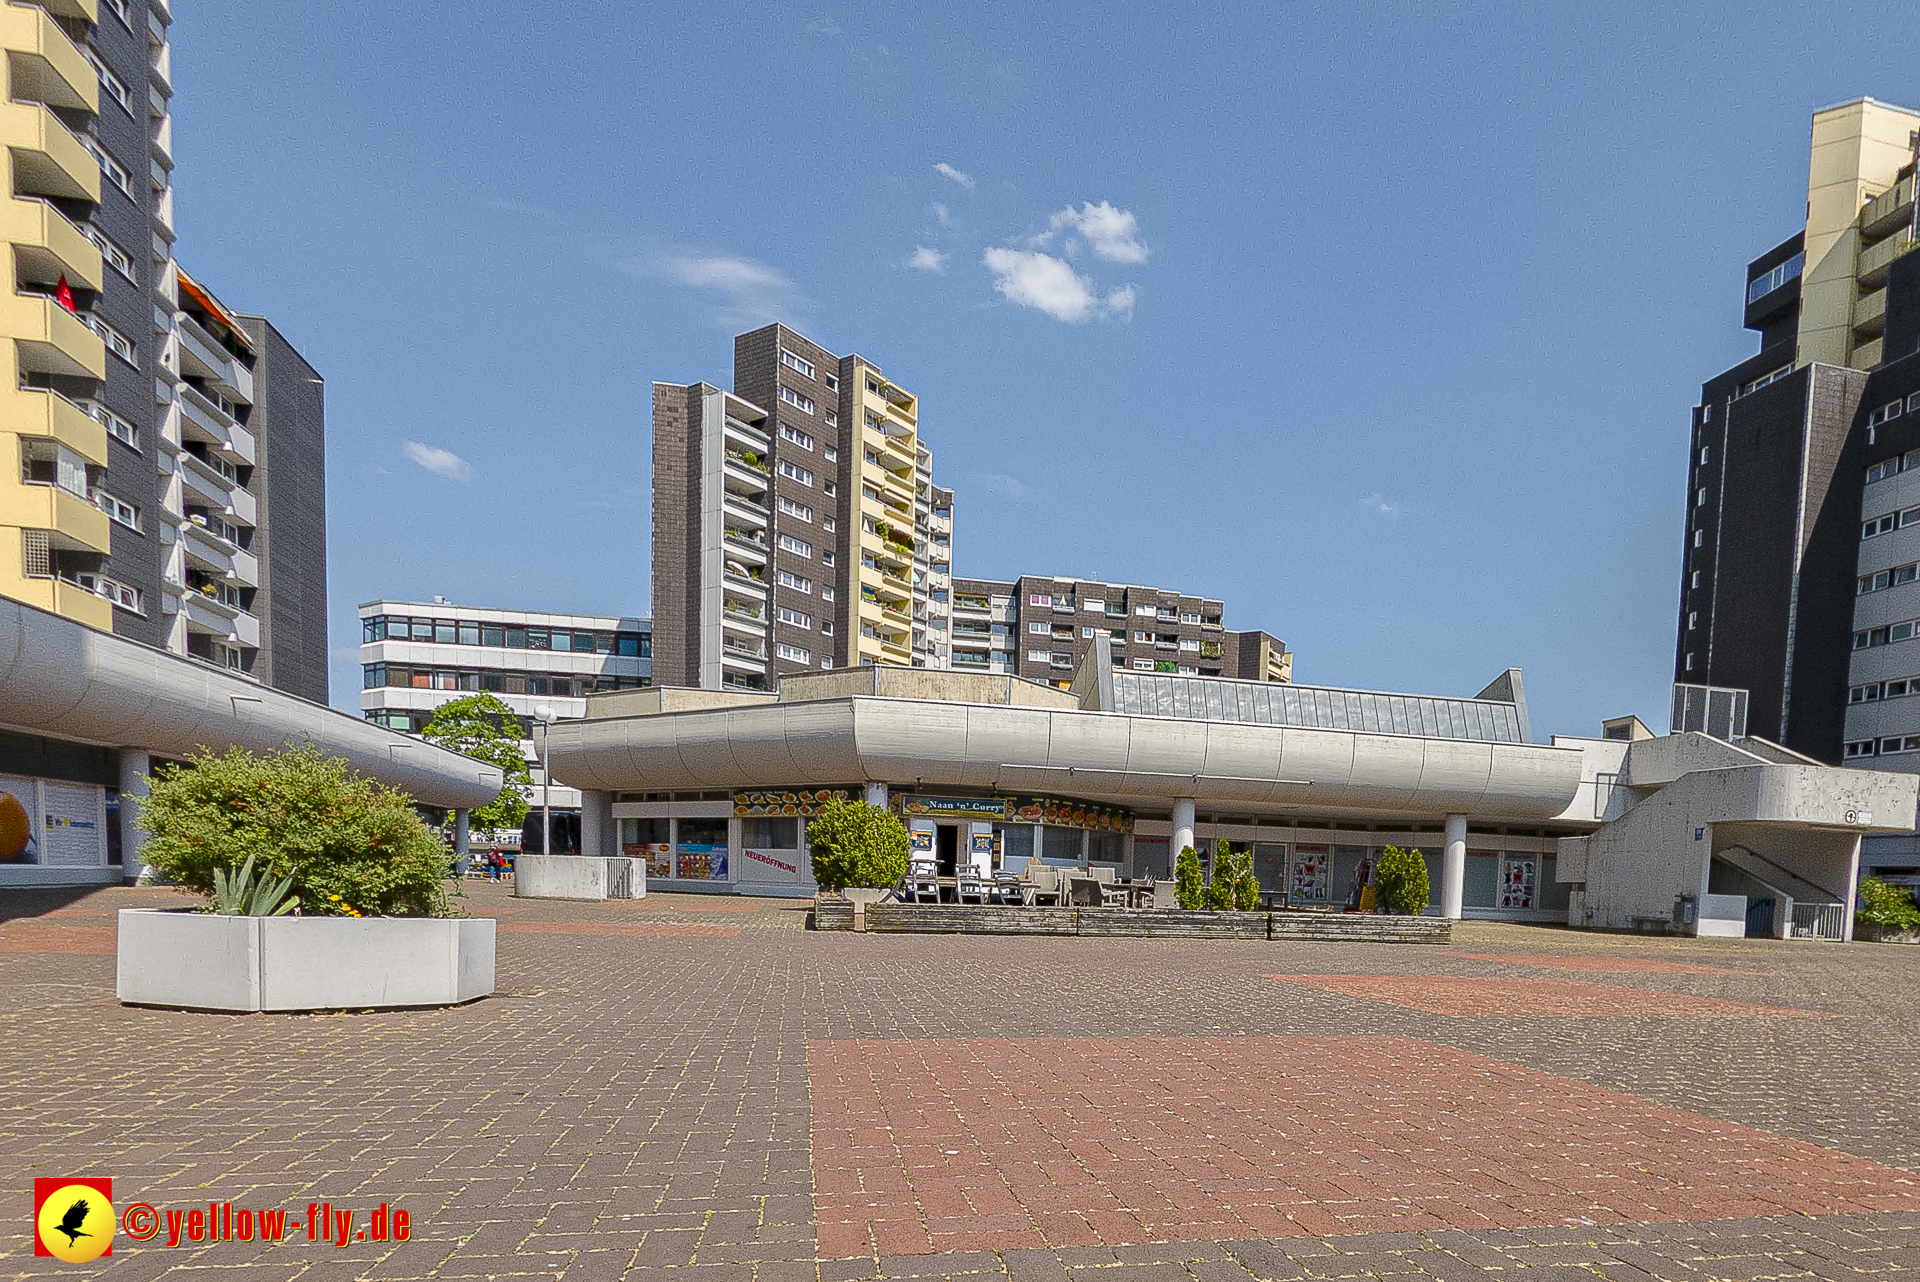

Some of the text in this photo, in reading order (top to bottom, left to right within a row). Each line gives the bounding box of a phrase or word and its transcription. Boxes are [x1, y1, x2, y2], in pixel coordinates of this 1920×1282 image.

[929, 800, 954, 809] Naan
[972, 802, 1000, 813] Curry
[744, 849, 797, 874] NEUERÖFFNUNG
